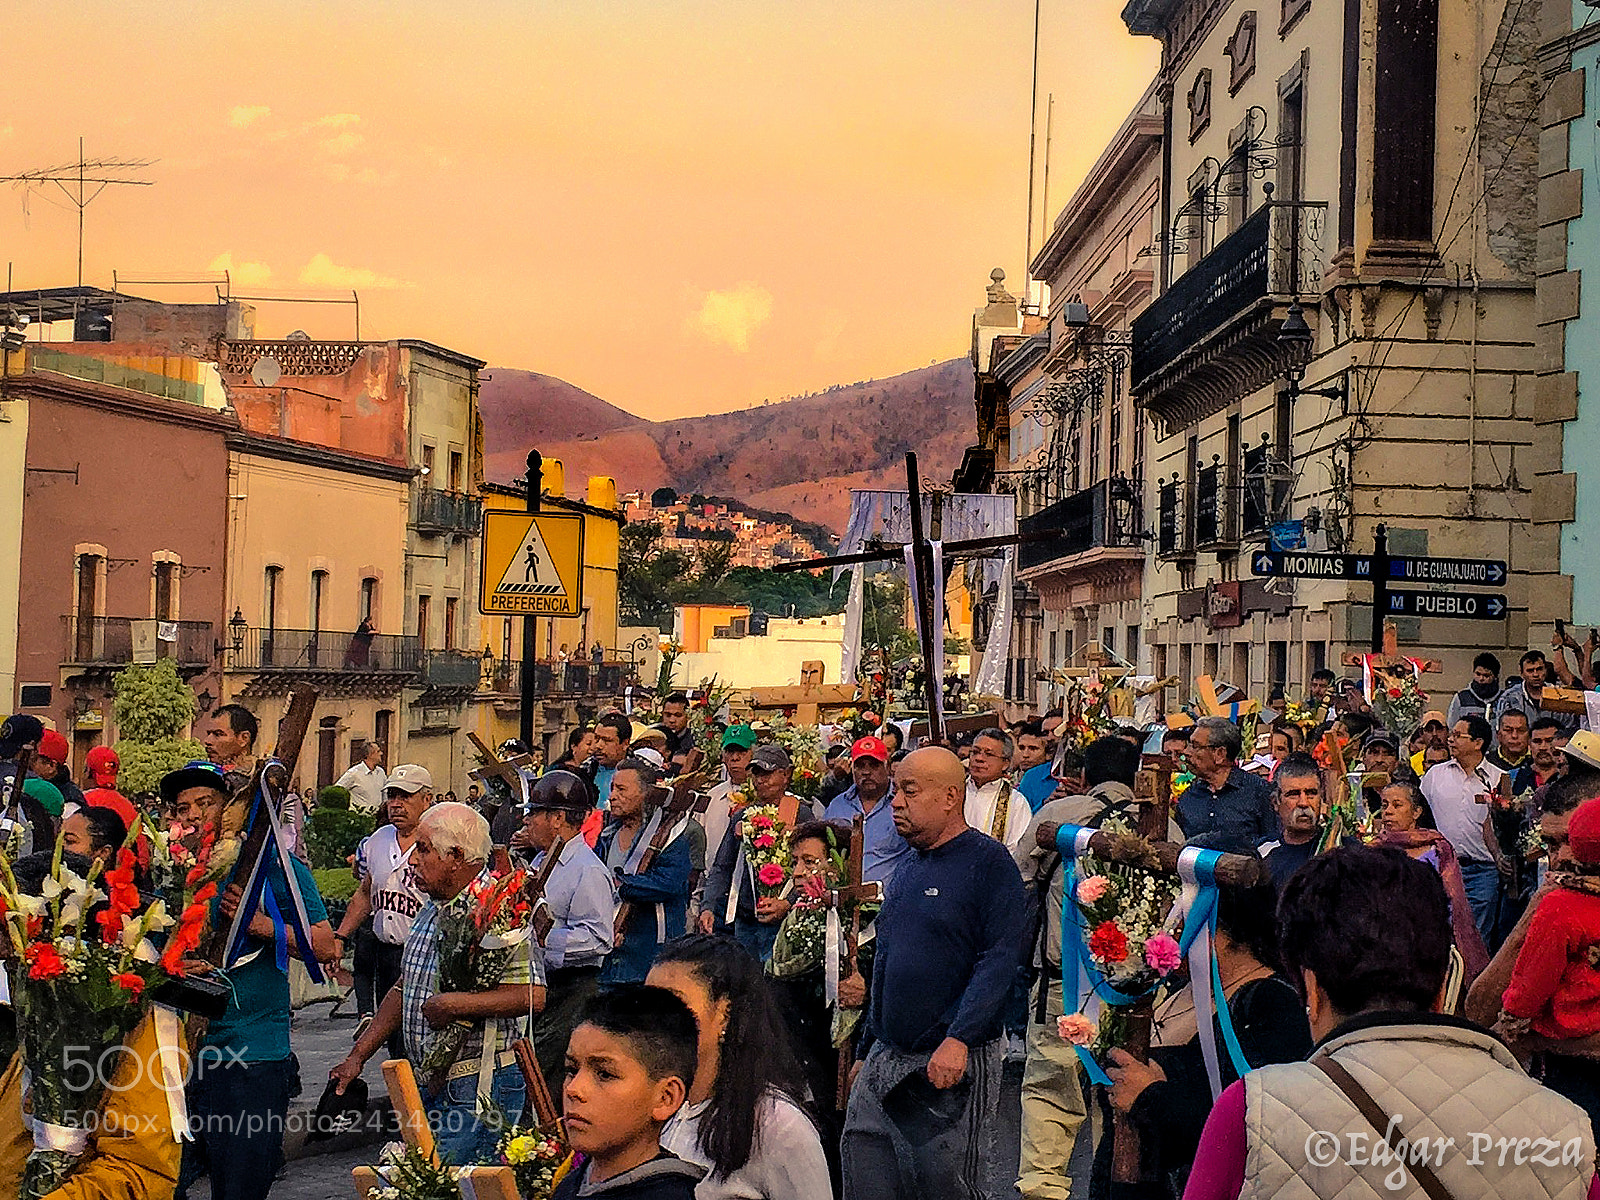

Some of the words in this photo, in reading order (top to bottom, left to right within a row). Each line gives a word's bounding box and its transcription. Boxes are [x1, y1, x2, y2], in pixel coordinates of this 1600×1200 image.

[1283, 556, 1344, 575] MOMIAS
[1406, 561, 1415, 578] U.
[1416, 561, 1429, 578] DE
[1429, 562, 1486, 580] GUANAJUATO
[491, 595, 570, 611] PREFERENCIA
[1416, 595, 1477, 614] PUEBLO
